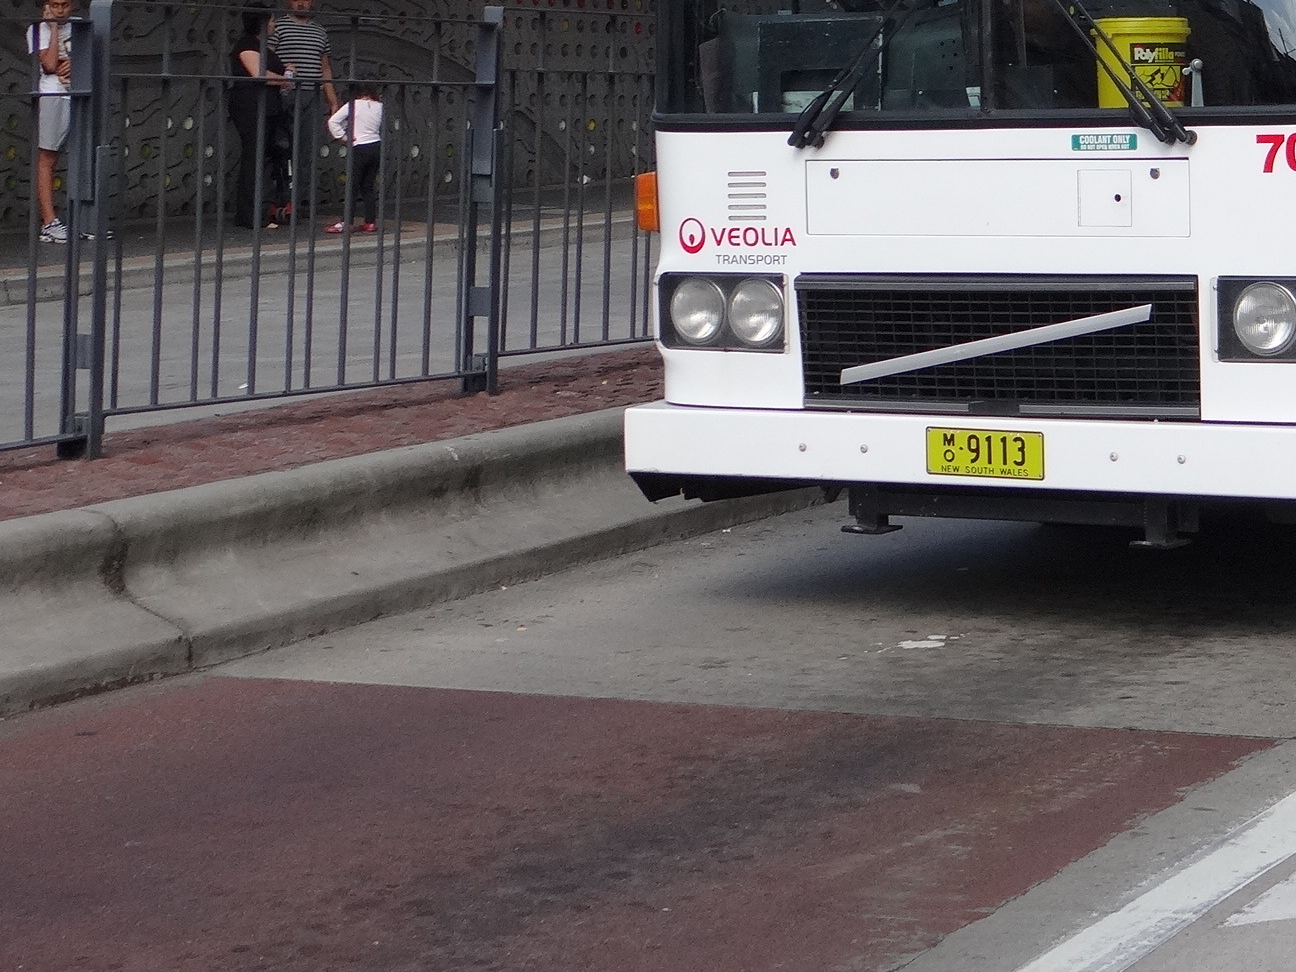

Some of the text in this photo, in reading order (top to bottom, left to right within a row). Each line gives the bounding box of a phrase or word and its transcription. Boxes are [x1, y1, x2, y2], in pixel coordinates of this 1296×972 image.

[1133, 47, 1175, 63] Polyfilla
[1079, 134, 1130, 144] COOLANT ONLY
[711, 227, 797, 246] VEOLIA
[715, 254, 788, 265] TRANSPORT
[965, 466, 995, 475] SOUTH
[1000, 467, 1029, 477] WALES
